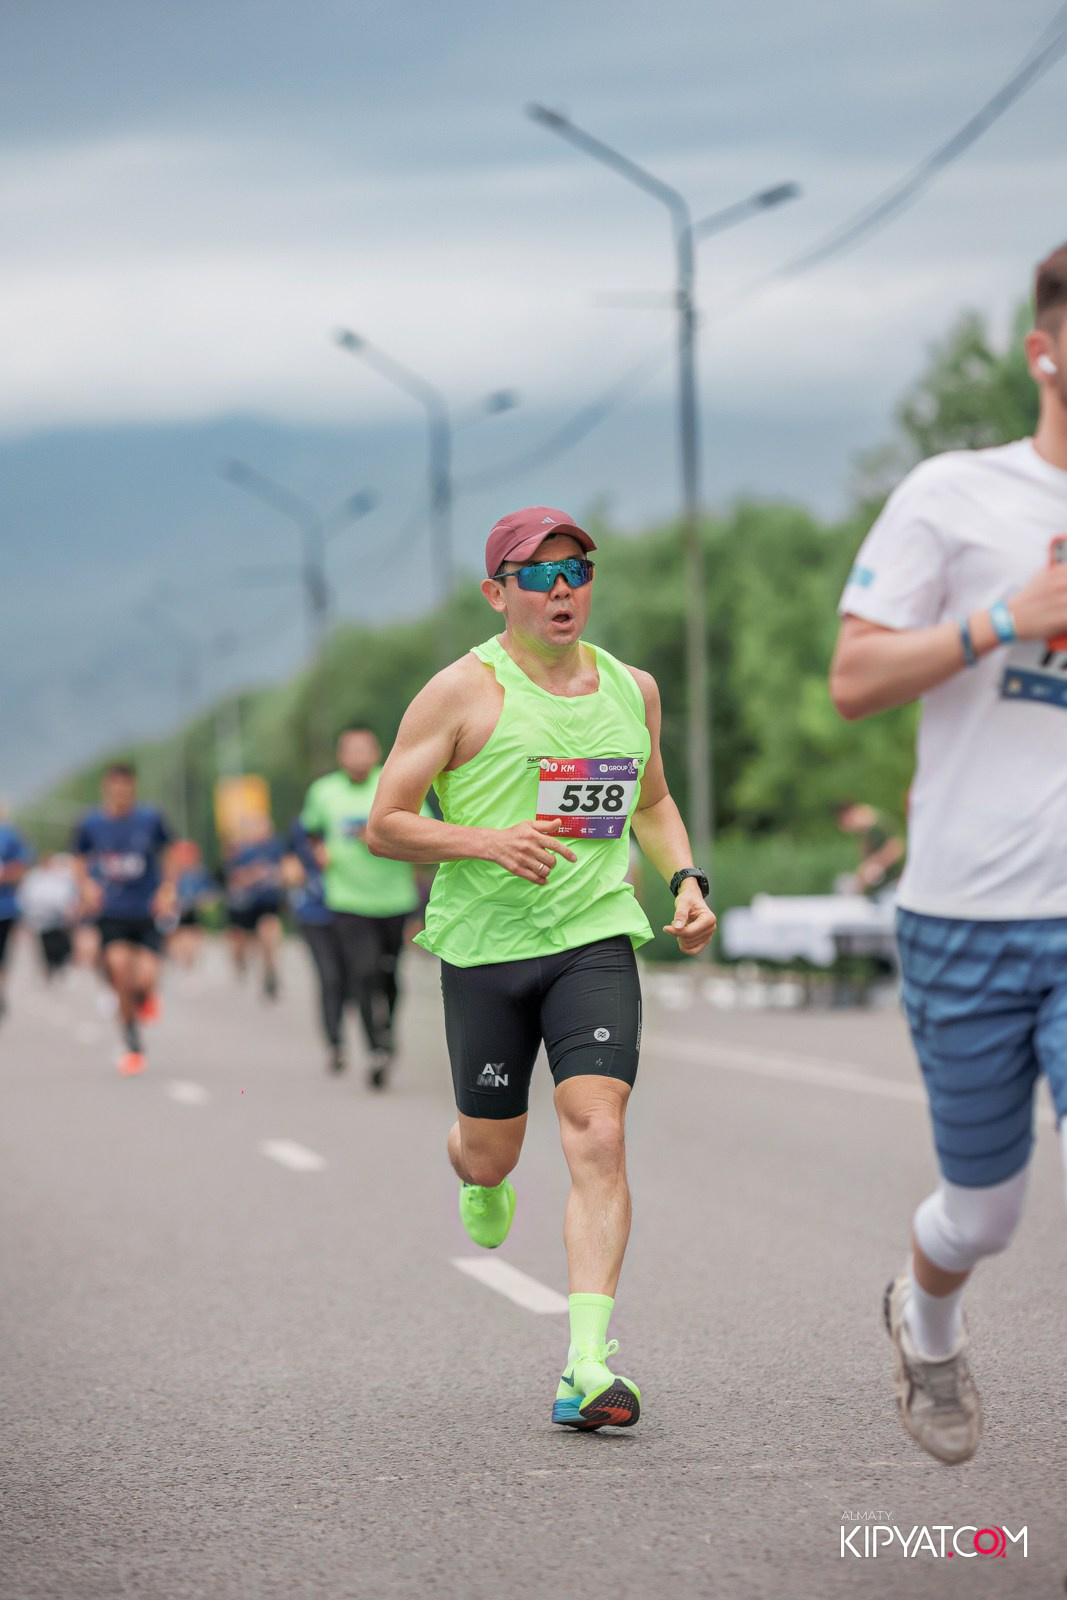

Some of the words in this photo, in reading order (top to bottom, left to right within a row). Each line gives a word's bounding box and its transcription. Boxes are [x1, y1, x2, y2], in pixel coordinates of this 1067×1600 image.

[560, 764, 575, 772] KM
[608, 764, 628, 772] GROUP
[558, 784, 625, 813] 538
